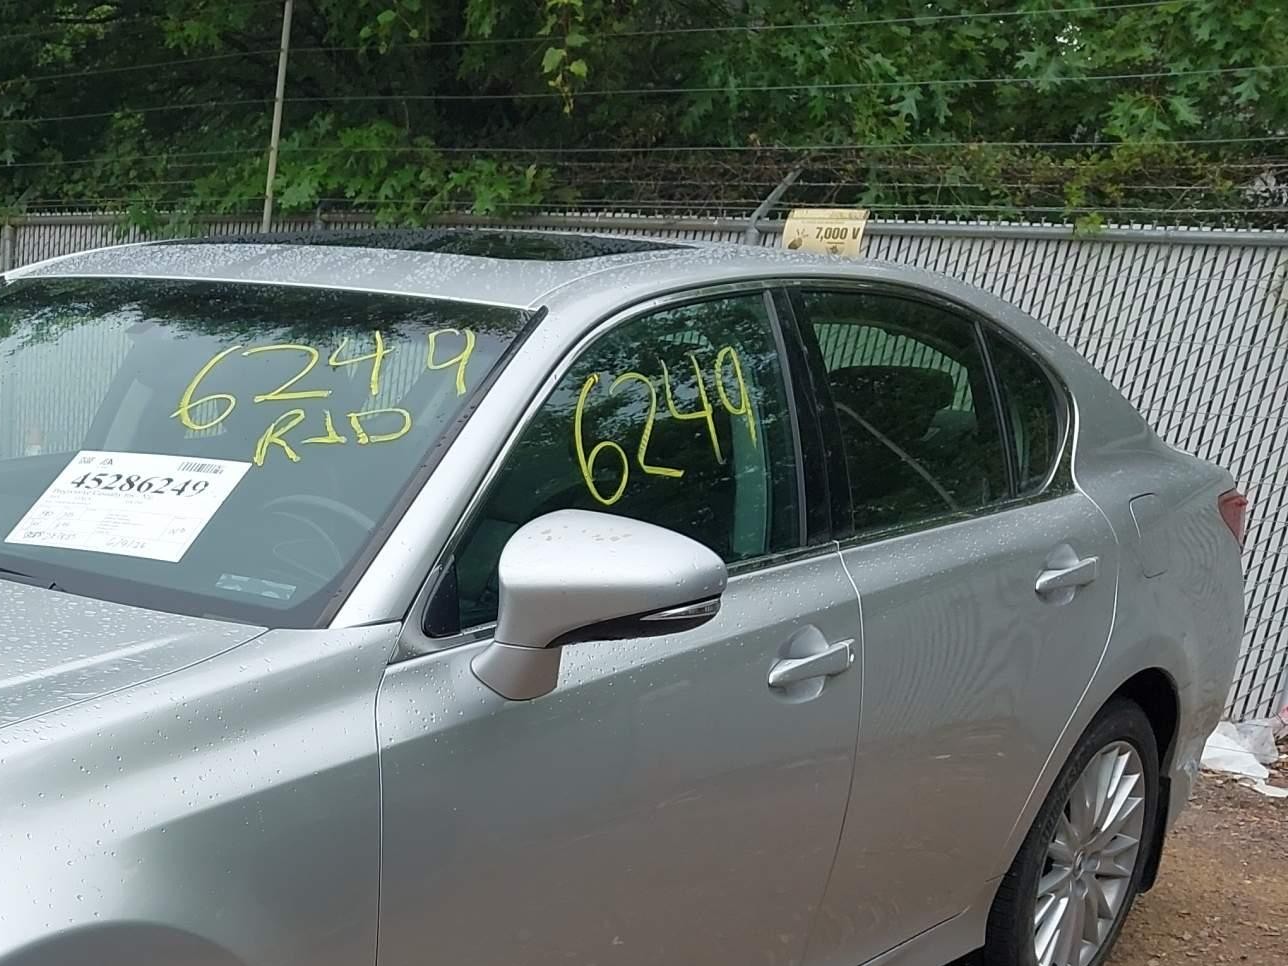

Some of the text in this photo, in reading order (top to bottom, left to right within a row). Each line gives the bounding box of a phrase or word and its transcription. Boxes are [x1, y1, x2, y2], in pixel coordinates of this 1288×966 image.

[815, 227, 849, 242] 7,000
[170, 328, 475, 431] 6249
[253, 408, 412, 466] RID
[574, 345, 758, 506] 6249
[71, 471, 210, 498] 45286249
